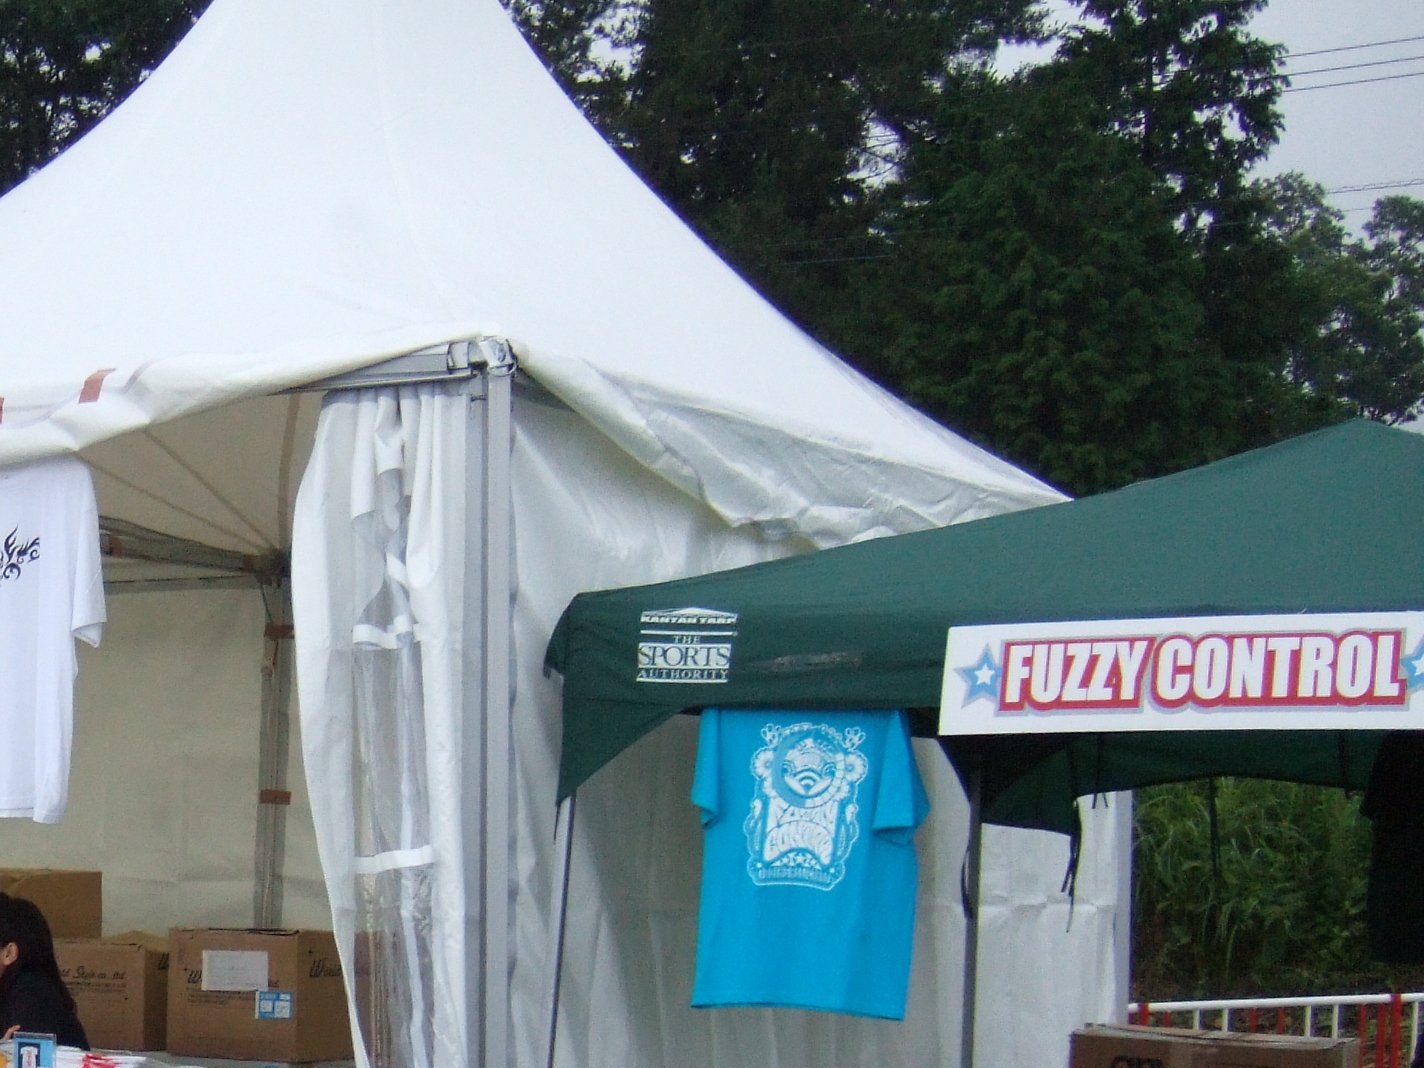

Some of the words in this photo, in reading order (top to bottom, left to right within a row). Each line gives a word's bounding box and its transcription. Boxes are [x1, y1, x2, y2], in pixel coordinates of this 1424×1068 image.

[672, 635, 701, 645] THE
[638, 645, 730, 667] SPORTS
[637, 669, 729, 679] AUTHORITY
[1005, 640, 1150, 704] FUZZY
[1155, 634, 1401, 701] CONTROL
